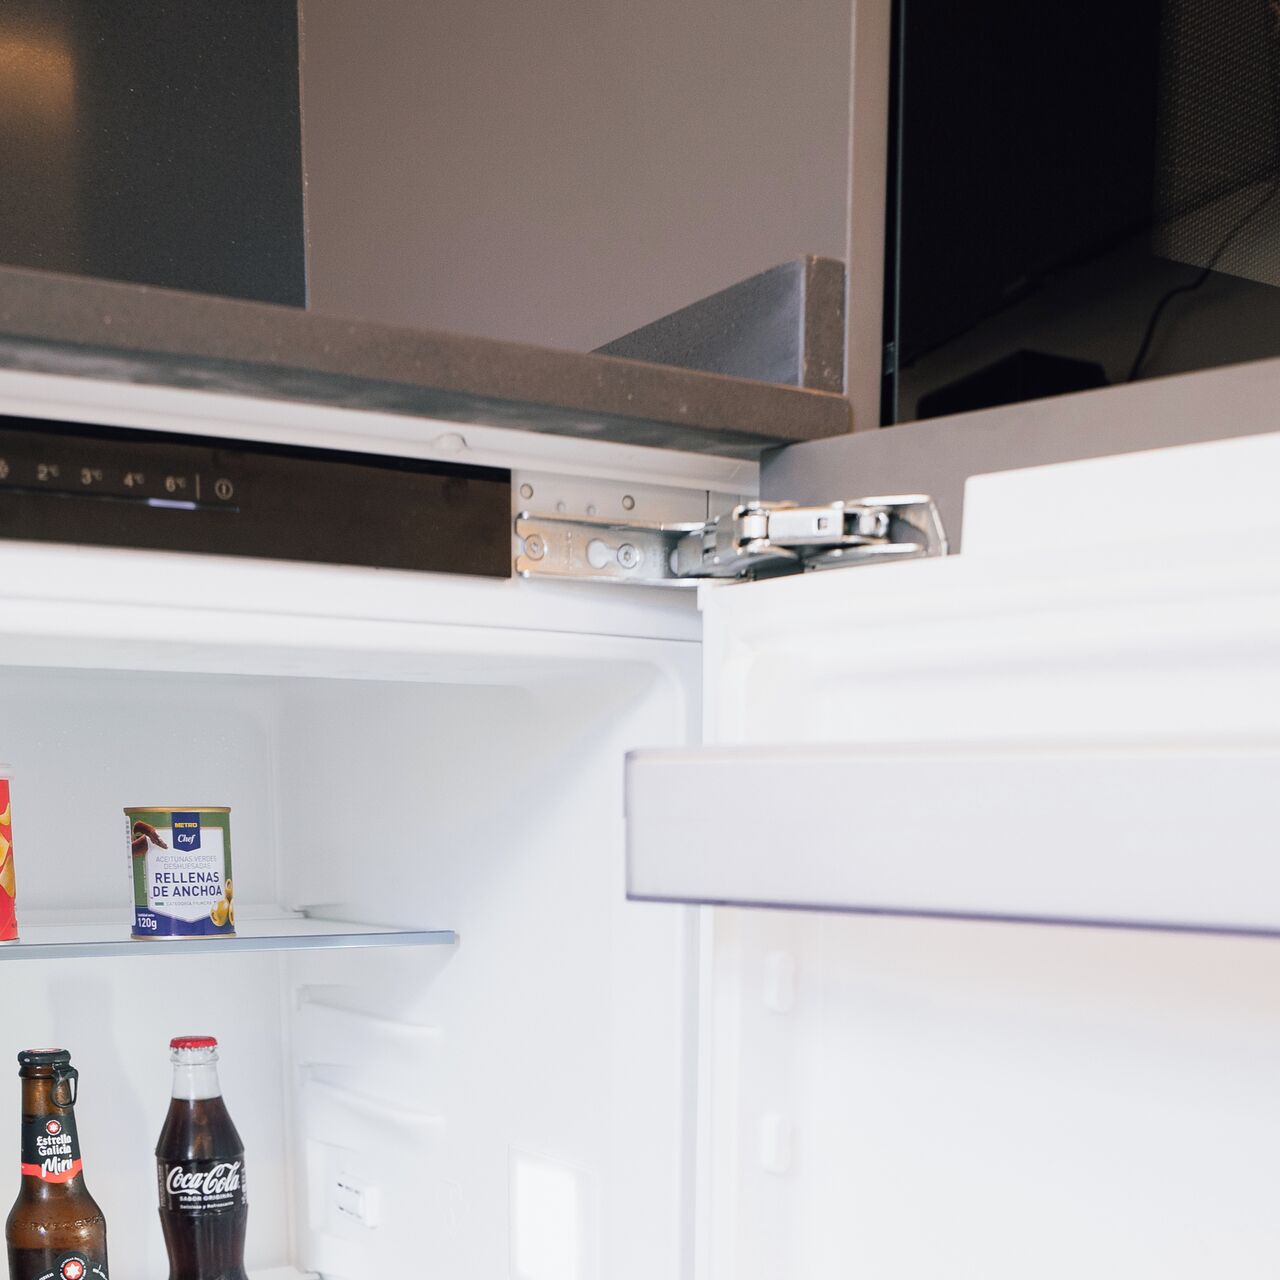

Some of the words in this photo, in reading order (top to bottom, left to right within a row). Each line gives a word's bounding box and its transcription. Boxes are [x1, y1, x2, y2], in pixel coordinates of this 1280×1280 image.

[177, 834, 196, 845] Chef
[156, 855, 193, 863] ACEITUNAS
[155, 872, 220, 884] RELLENAS
[153, 886, 169, 897] DE
[173, 885, 223, 897] ANCHOA
[137, 917, 157, 930] 120g
[37, 1134, 72, 1147] Estrella
[38, 1144, 72, 1157] Galicia
[41, 1154, 74, 1178] Mini
[166, 1161, 242, 1195] Coca-Cola
